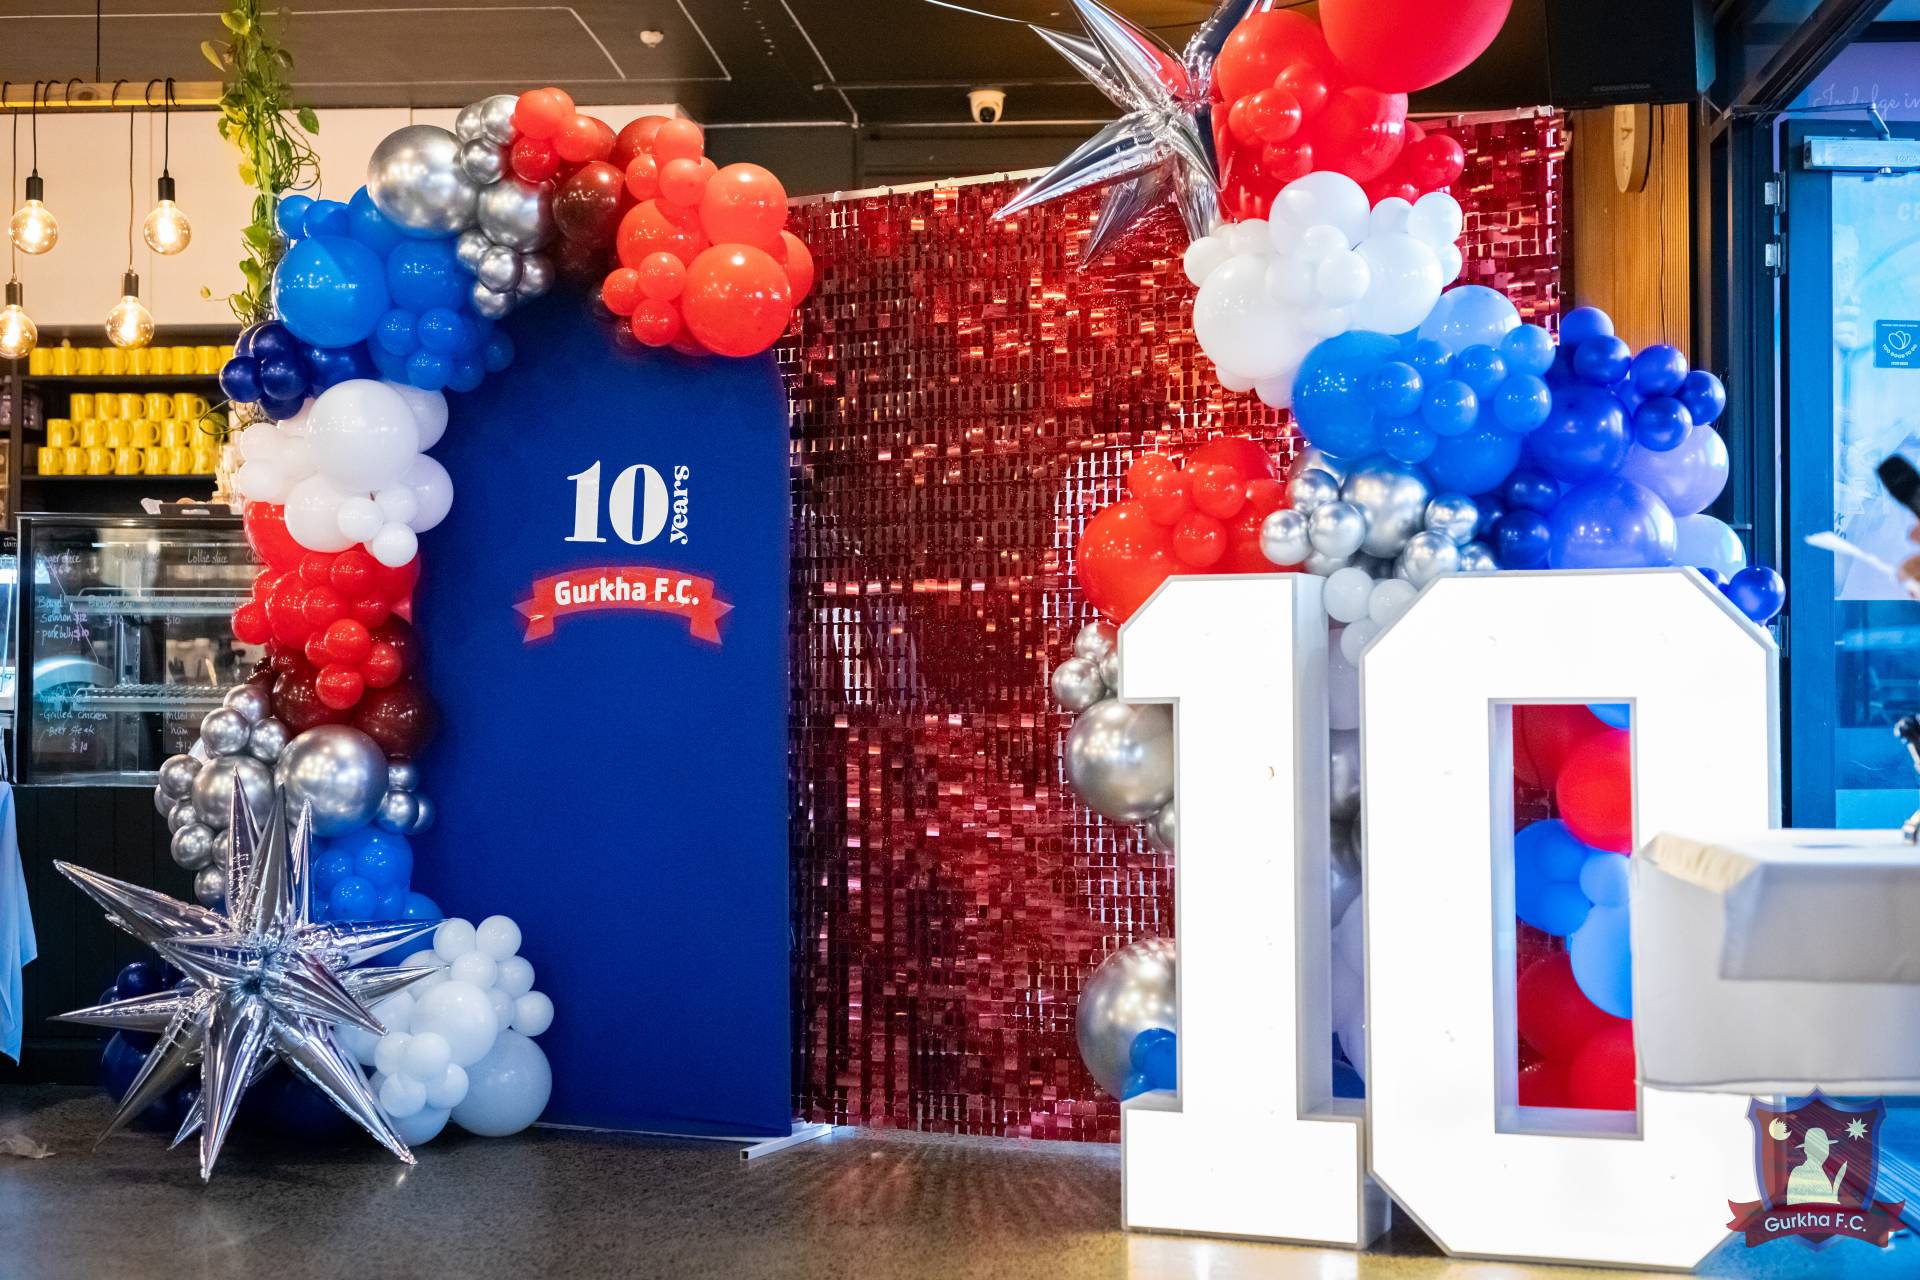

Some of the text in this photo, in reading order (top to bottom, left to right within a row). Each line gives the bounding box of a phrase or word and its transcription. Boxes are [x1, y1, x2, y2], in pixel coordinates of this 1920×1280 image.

[1813, 84, 1900, 120] Indlge
[564, 460, 669, 545] 10
[670, 465, 690, 545] years
[554, 576, 700, 606] Gurkha F.C.
[1120, 565, 1784, 1269] 10
